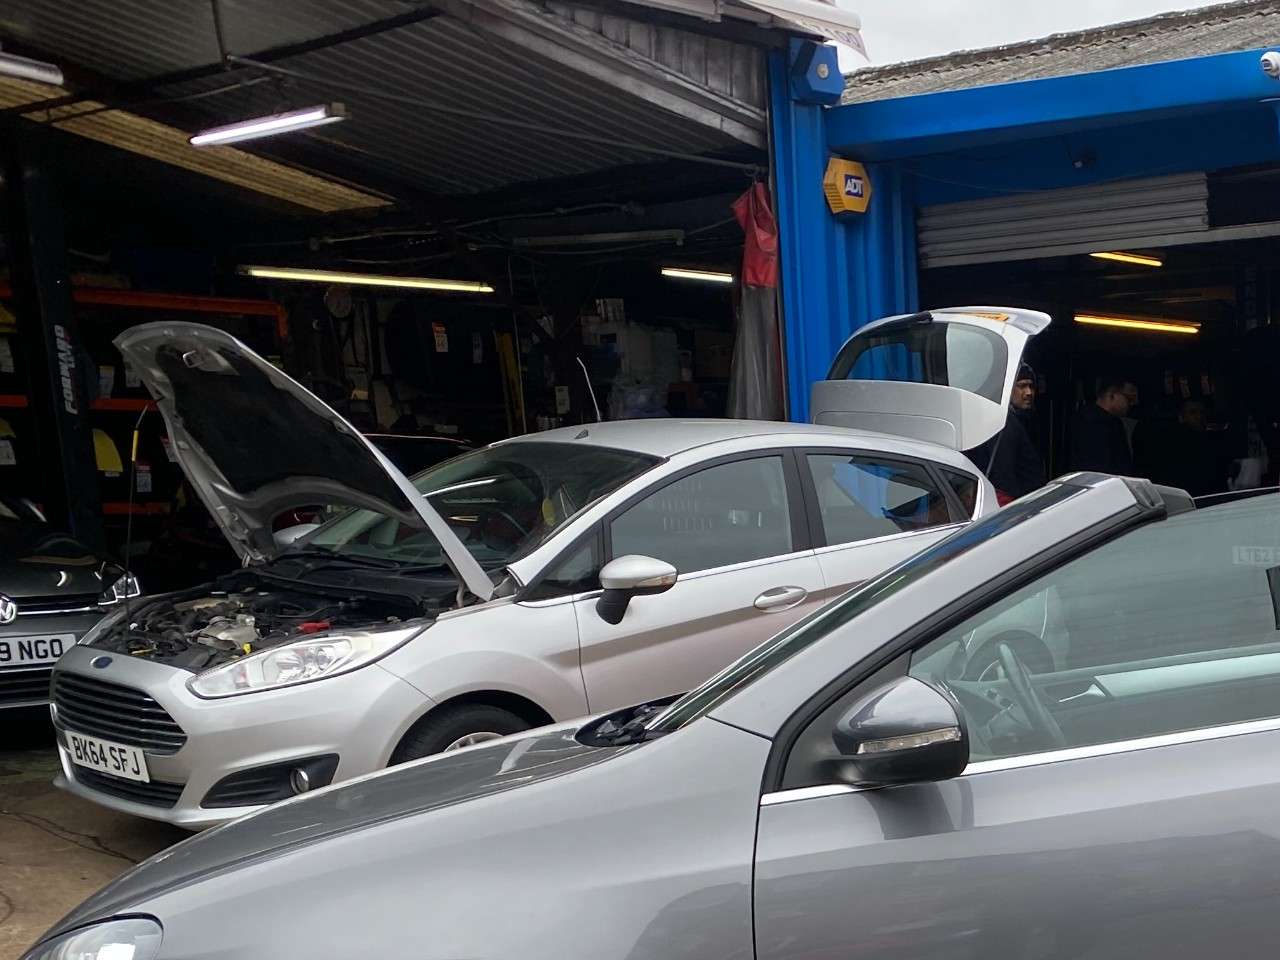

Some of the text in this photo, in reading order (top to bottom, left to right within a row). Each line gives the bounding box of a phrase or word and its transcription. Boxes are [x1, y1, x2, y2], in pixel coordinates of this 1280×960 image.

[845, 178, 864, 195] ADT
[18, 638, 64, 660] NGO
[71, 736, 108, 768] BK64
